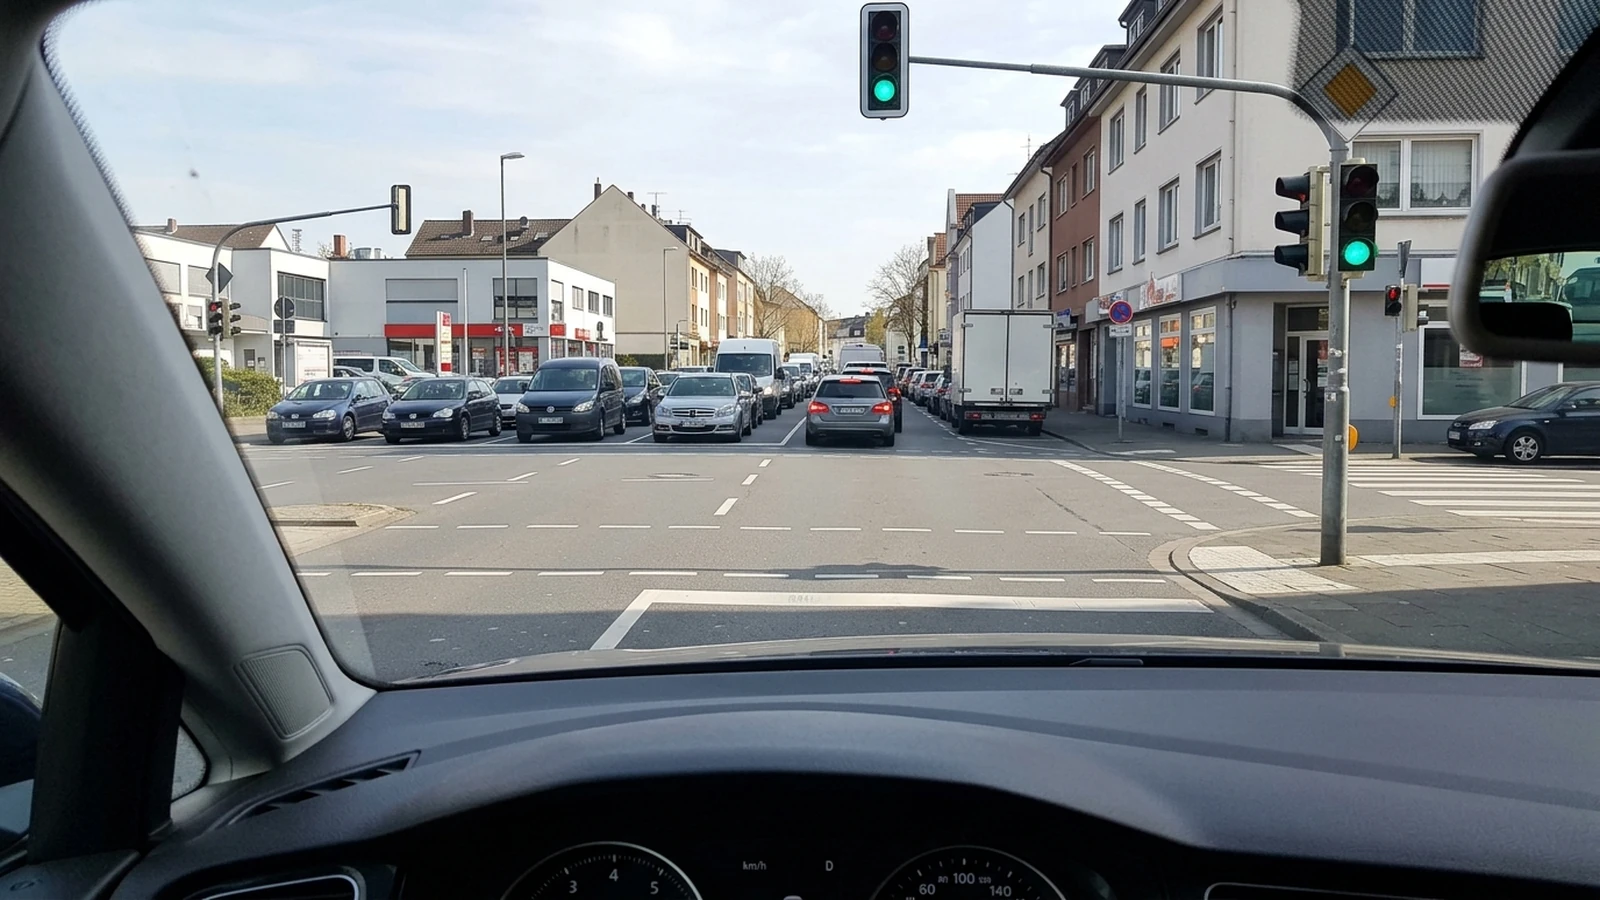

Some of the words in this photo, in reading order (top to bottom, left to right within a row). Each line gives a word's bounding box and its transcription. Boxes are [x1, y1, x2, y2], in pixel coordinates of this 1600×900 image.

[742, 860, 768, 871] km/h
[825, 860, 835, 872] D
[608, 868, 619, 882] 4
[952, 872, 976, 885] 100
[568, 880, 578, 894] 3
[650, 880, 659, 895] 5
[918, 883, 936, 896] 60
[989, 885, 1012, 897] 140
